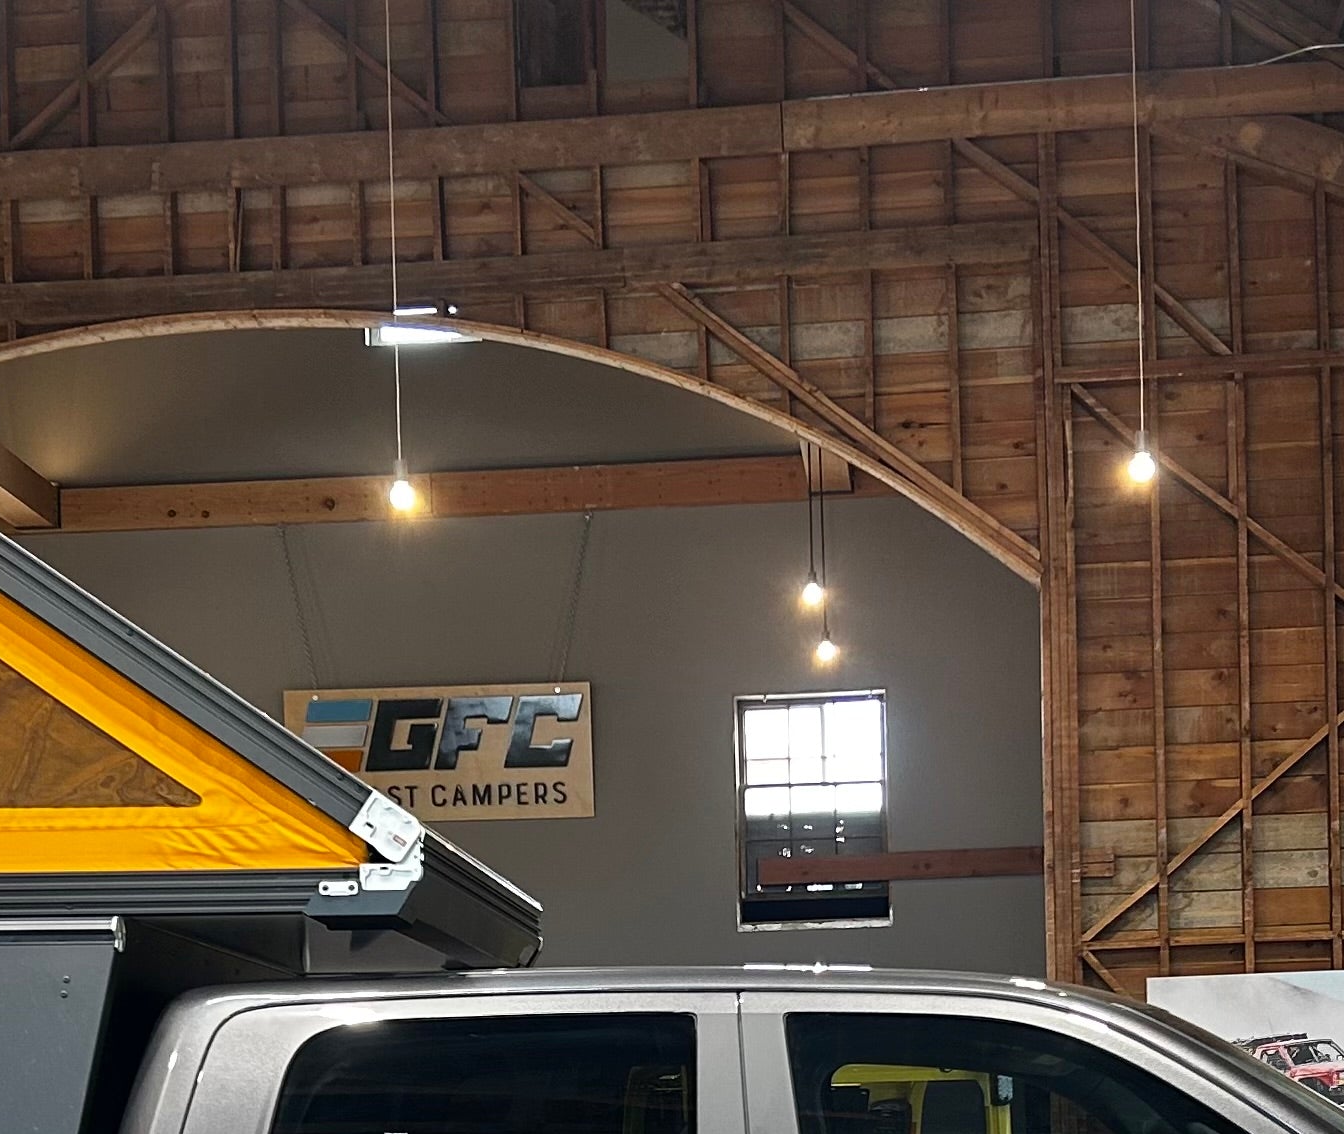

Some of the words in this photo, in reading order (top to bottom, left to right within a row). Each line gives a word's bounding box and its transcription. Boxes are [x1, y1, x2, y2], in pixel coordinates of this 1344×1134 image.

[365, 694, 583, 771] GFC
[373, 785, 418, 808] ST
[431, 781, 568, 807] CAMPERS
